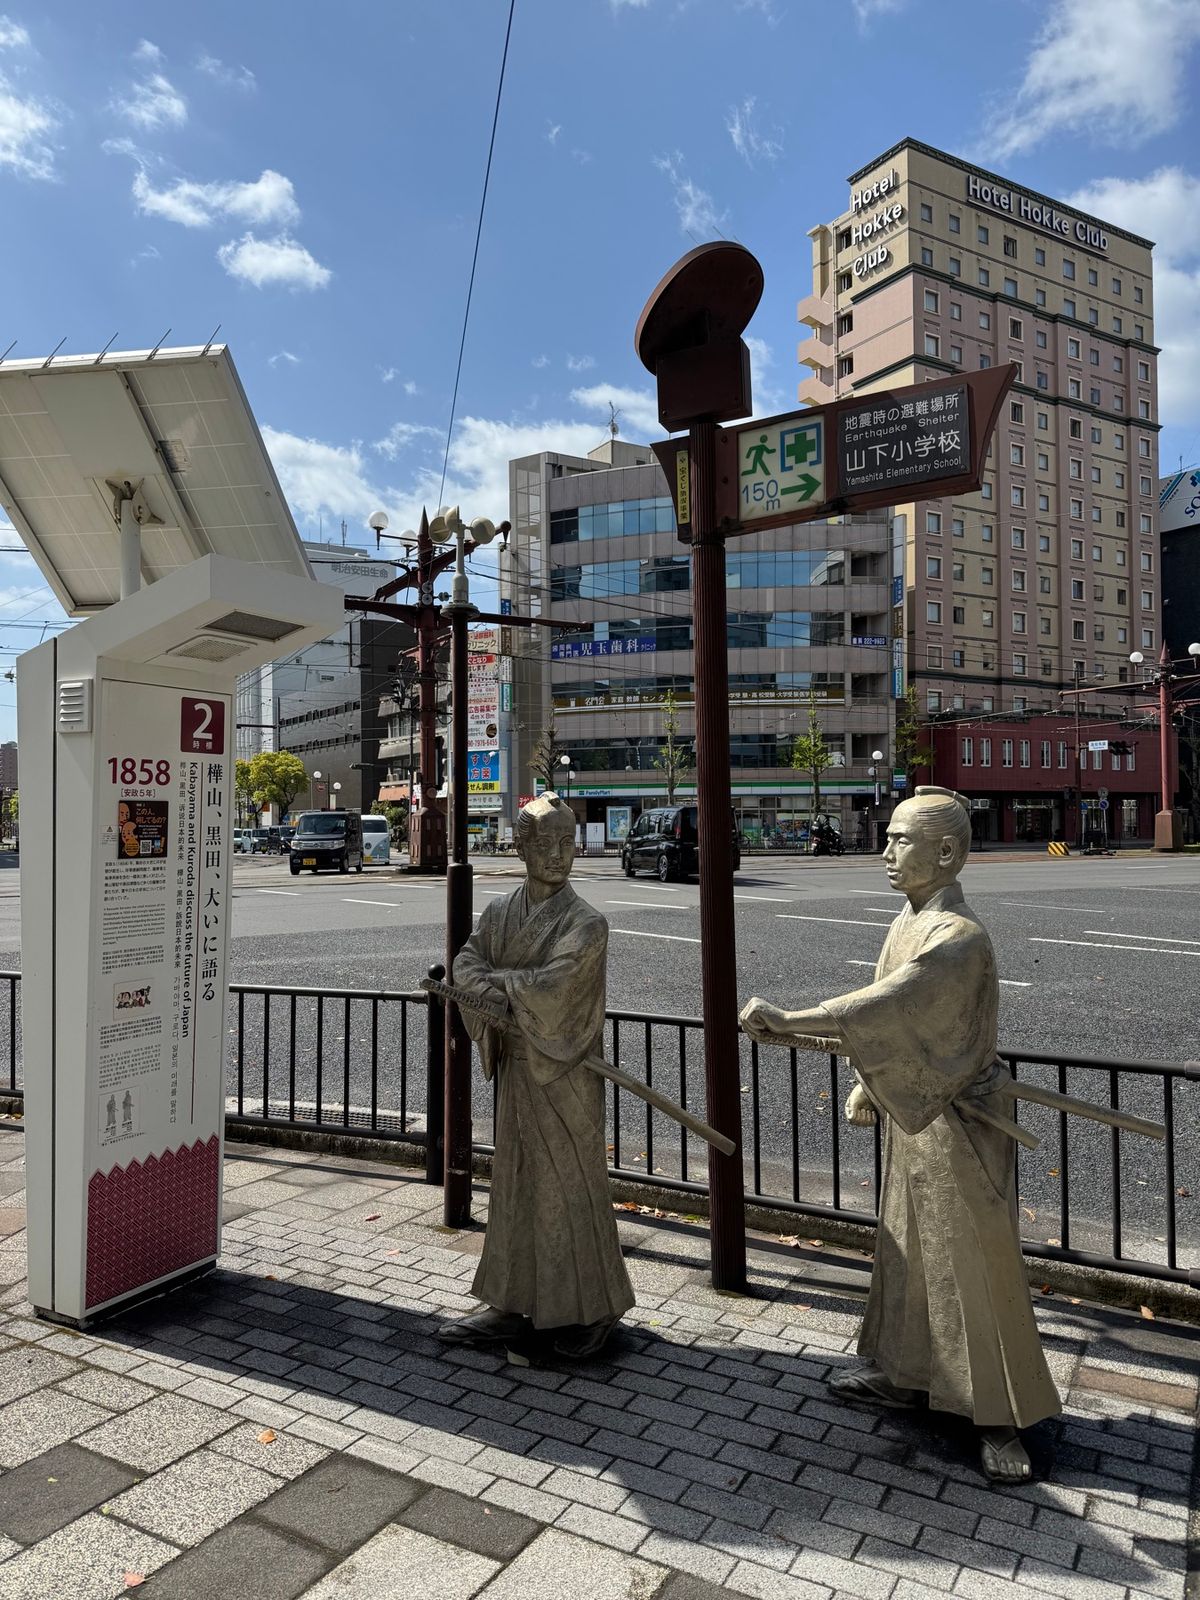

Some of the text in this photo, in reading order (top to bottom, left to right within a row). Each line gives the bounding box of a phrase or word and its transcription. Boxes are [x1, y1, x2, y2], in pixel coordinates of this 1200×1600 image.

[851, 168, 897, 213] Hotel
[851, 202, 903, 246] Hokke
[967, 174, 1109, 251] Hotel Hokke Club
[853, 245, 889, 277] Club
[844, 392, 960, 431] 地震時の避難場所
[844, 411, 960, 443] Earthquake Shelter
[846, 429, 961, 472] 山下小学校
[845, 456, 962, 487] Yamashita Elementary School
[741, 479, 779, 505] 150
[765, 499, 781, 512] m
[581, 638, 638, 656] 児玉歯科
[193, 703, 212, 739] 2
[108, 757, 171, 786] 1858
[467, 782, 495, 791] せん調剤
[181, 762, 198, 1038] Kabayama and Kuroda discuss the future of Japan
